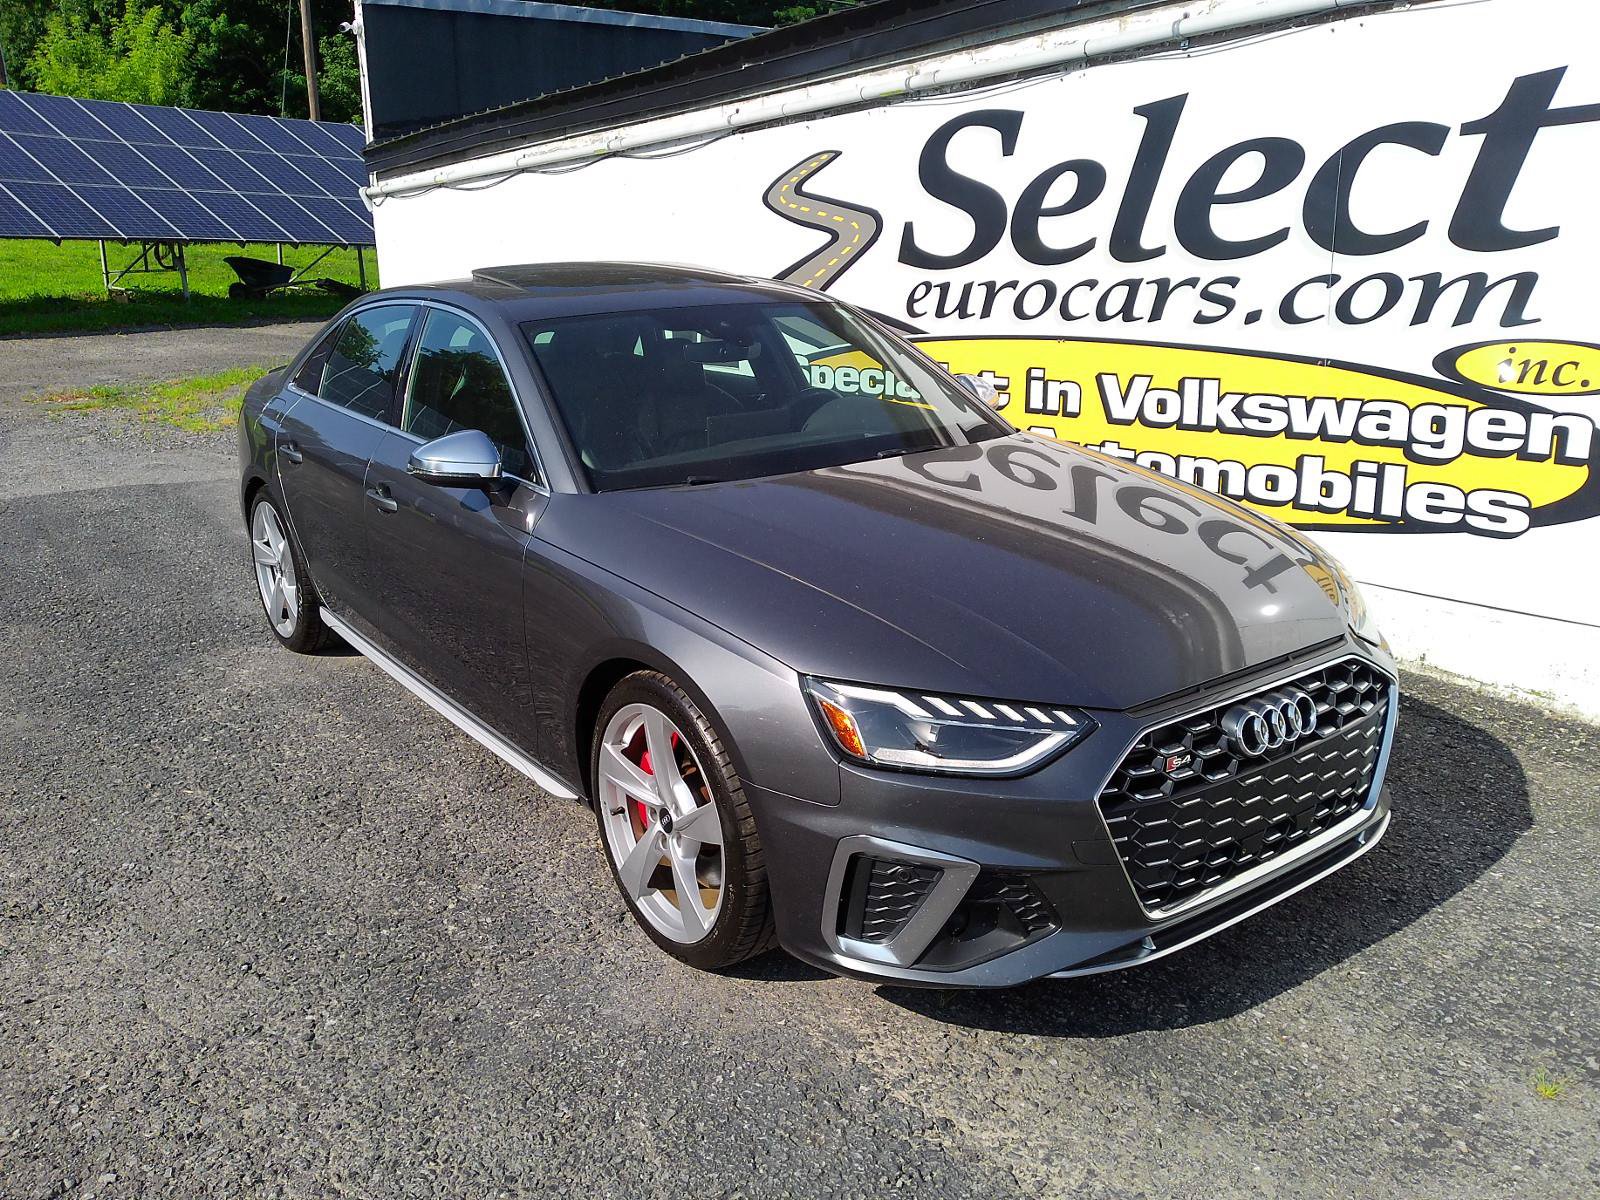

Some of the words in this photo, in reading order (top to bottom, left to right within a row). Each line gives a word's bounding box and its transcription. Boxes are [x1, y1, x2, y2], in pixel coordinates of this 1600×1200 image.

[897, 65, 1600, 269] Select
[905, 271, 1543, 327] eurocars.com
[1496, 346, 1591, 388] inc.
[1025, 366, 1082, 418] in
[1095, 373, 1596, 468] Volkswagen
[1028, 426, 1532, 540] omobiles
[1172, 754, 1192, 767] S4
